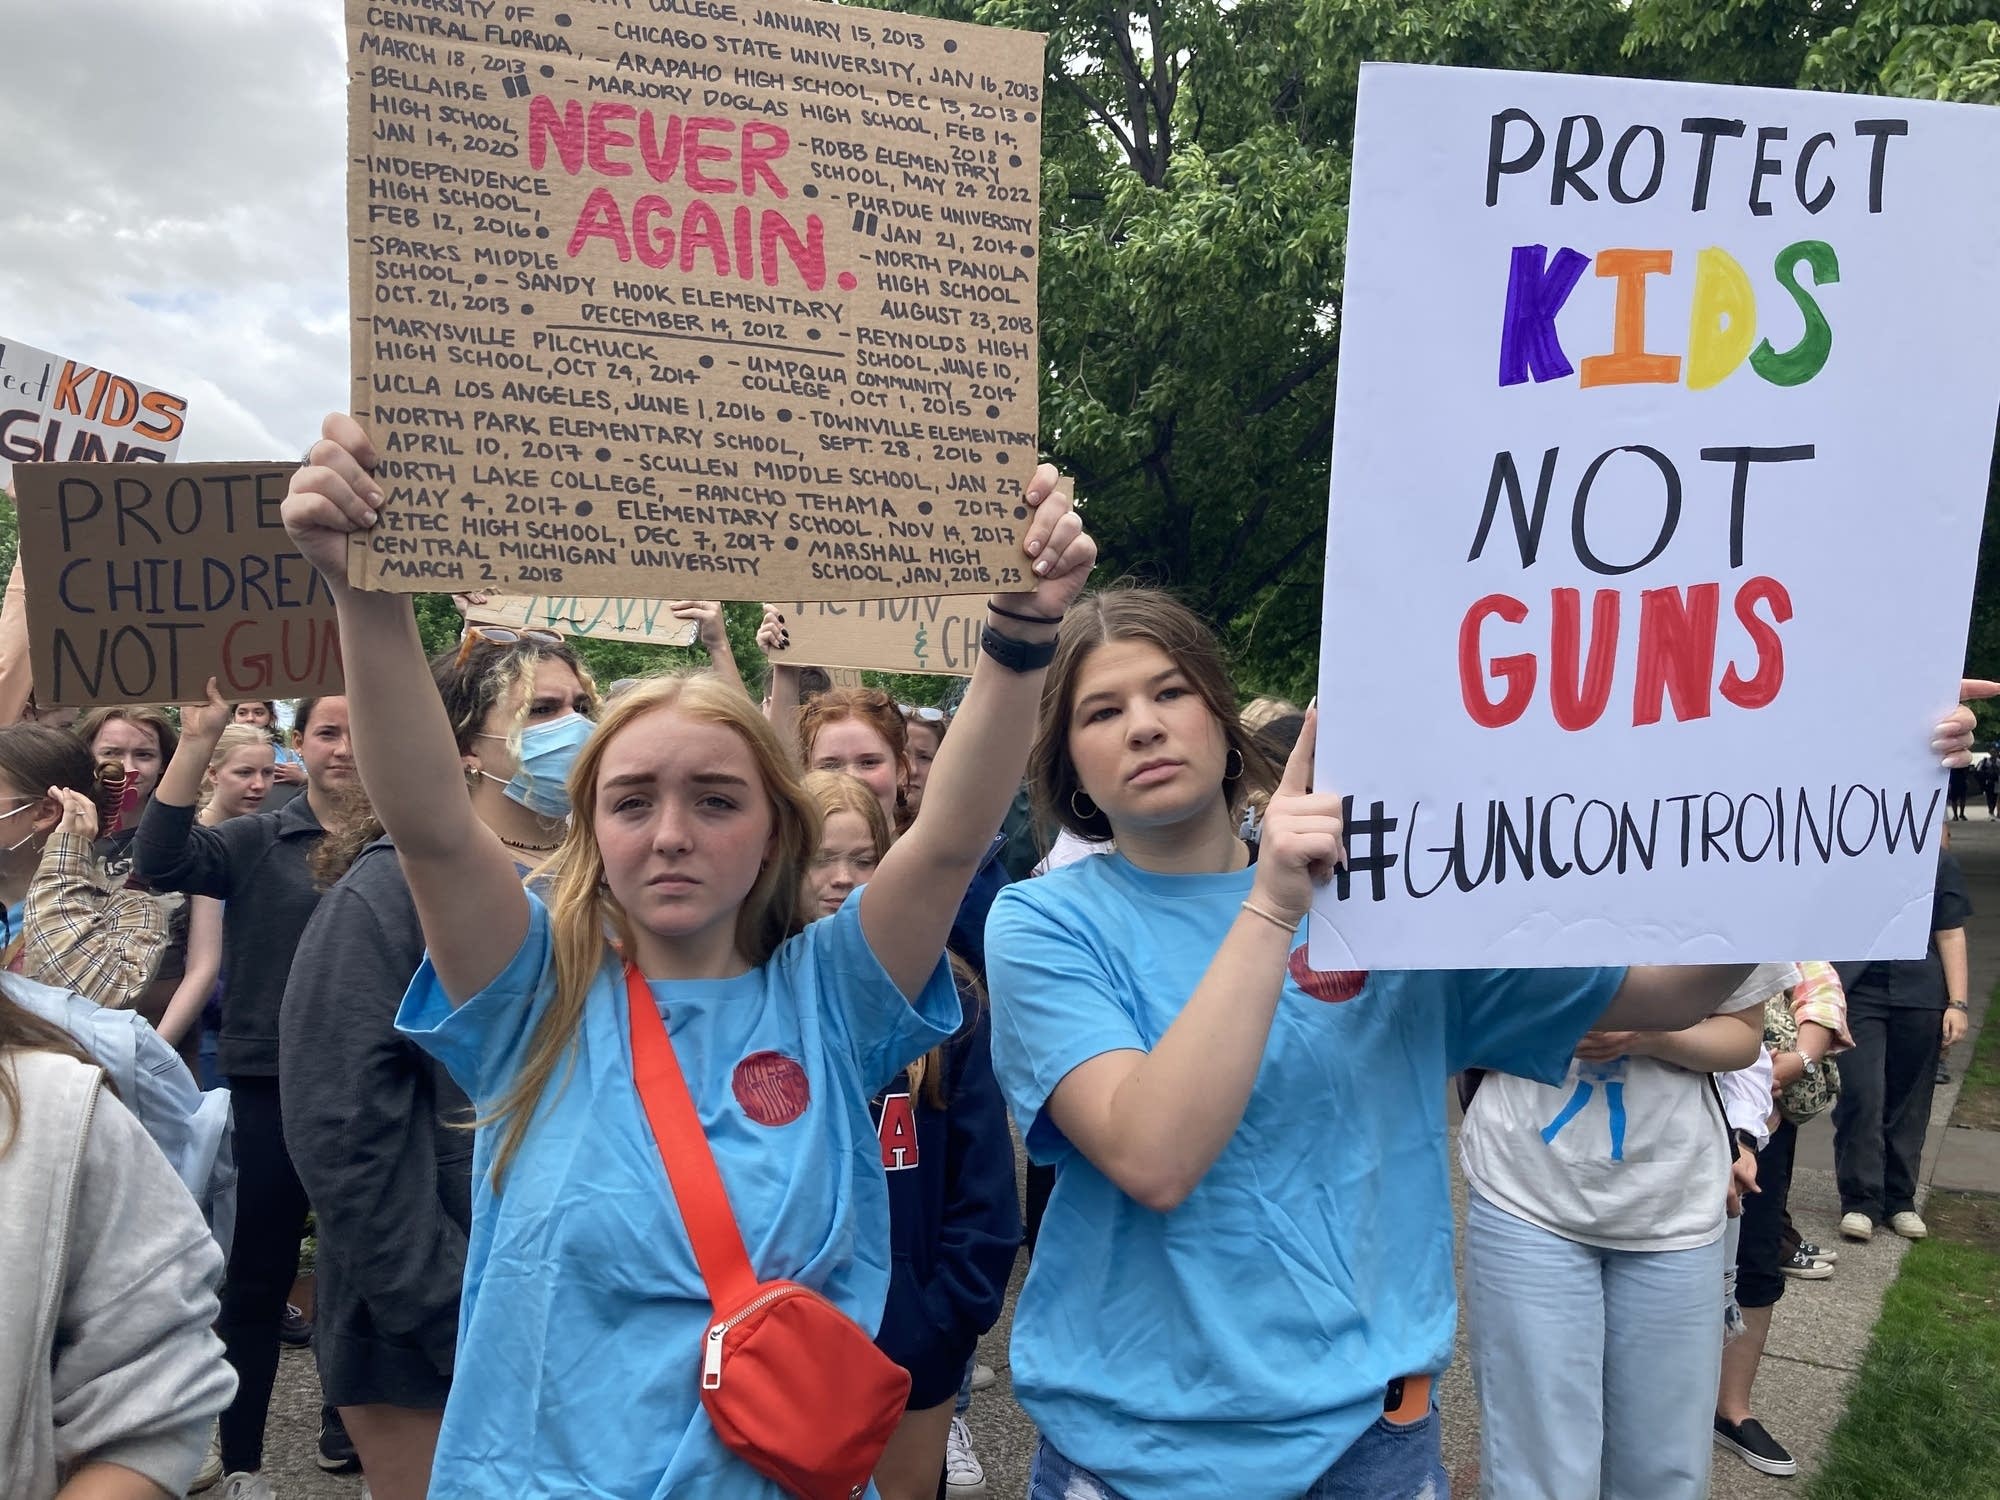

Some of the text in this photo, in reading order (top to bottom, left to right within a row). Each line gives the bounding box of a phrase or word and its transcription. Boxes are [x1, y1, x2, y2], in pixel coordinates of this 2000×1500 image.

[367, 7, 478, 41] CENTRAL
[505, 6, 535, 22] OF
[753, 10, 841, 42] JANUARY
[851, 25, 875, 49] 15,
[883, 28, 925, 49] 2013
[359, 32, 526, 74] MARCH 2013
[614, 21, 974, 89] CHICAGO STATE UNIVERSITY, JAN
[371, 66, 487, 100] BELLAIRE
[616, 51, 1018, 122] ARAPAHO HIGH SCHOOL, DEC 2013
[370, 93, 519, 141] HIGH SCHOOL,
[588, 75, 692, 105] MARJORY
[704, 90, 789, 116] DOGLAS
[801, 103, 851, 124] HIGH
[861, 109, 938, 140] SCHOOL,
[946, 122, 986, 142] FEB
[373, 119, 415, 143] JAN
[427, 129, 457, 152] 14,
[528, 95, 790, 200] NEVER
[951, 145, 997, 164] 2018
[1486, 108, 1908, 216] PROTECT
[811, 162, 1032, 203] SCHOOL, MAY 24 2022
[369, 179, 539, 222] HIGH SCHOOL,
[368, 204, 420, 228] FEB
[433, 212, 463, 235] 12,
[941, 207, 1032, 235] UNIVERSITY
[566, 187, 857, 292] AGAIN.
[881, 224, 1017, 255] JAN 21, 2014
[376, 261, 472, 291] SCHOOL,
[475, 248, 558, 270] MIDDLE
[948, 259, 1029, 283] PANOLA
[376, 284, 510, 315] OCT. 21, 2013
[516, 271, 843, 323] SANDY HOOK ELEMENTARY
[877, 273, 1021, 304] HIGH SCHOOL
[581, 303, 787, 340] DECEMBER 2012
[880, 299, 962, 325] AUGUST
[1499, 240, 1840, 391] KIDS
[376, 341, 436, 362] HIGH
[649, 364, 700, 385] 2014
[533, 331, 658, 361] PILCHUCK
[978, 338, 1029, 360] HIGH
[748, 356, 847, 385] UMPQUA
[856, 371, 1017, 402] COMMUNITY 2014
[993, 363, 1021, 384] 10,
[53, 360, 187, 442] KIDS
[455, 379, 494, 399] LOS
[502, 381, 618, 415] ANGELES,
[625, 393, 689, 415] JUNE
[850, 390, 888, 408] OCT
[923, 397, 972, 417] 2015
[386, 431, 583, 462] APRIL 10, 2017
[474, 410, 541, 435] PARK
[549, 416, 703, 448] ELEMENTARY
[713, 432, 804, 461] SCHOOL,
[819, 434, 874, 453] SEPT.
[932, 444, 983, 464] 2016
[929, 425, 1037, 448] ELEMENTARY
[473, 465, 540, 488] LAKE
[551, 470, 664, 502] COLLEGE,
[754, 461, 843, 484] MIDDLE
[850, 467, 940, 495] SCHOOL,
[946, 472, 987, 493] JAN
[387, 486, 450, 509] MAY
[505, 493, 568, 515] 2017
[796, 493, 898, 518] TEHAMA
[955, 500, 1008, 519] 2017
[1468, 444, 1815, 576] NOT
[462, 516, 519, 537] HIGH
[526, 521, 625, 548] SCHOOL,
[634, 525, 681, 547] DEC
[723, 532, 775, 551] 2017
[617, 500, 1015, 545] ELEMENTARY SCHOOL, NOV 2017
[500, 541, 616, 565] MICHIGAN
[631, 549, 760, 576] UNIVERSITY
[808, 540, 981, 565] MARSHALL HIGH
[379, 559, 464, 580] MARCH
[518, 565, 563, 583] 2018
[53, 623, 204, 702] NOT
[1458, 575, 1794, 731] GUNS
